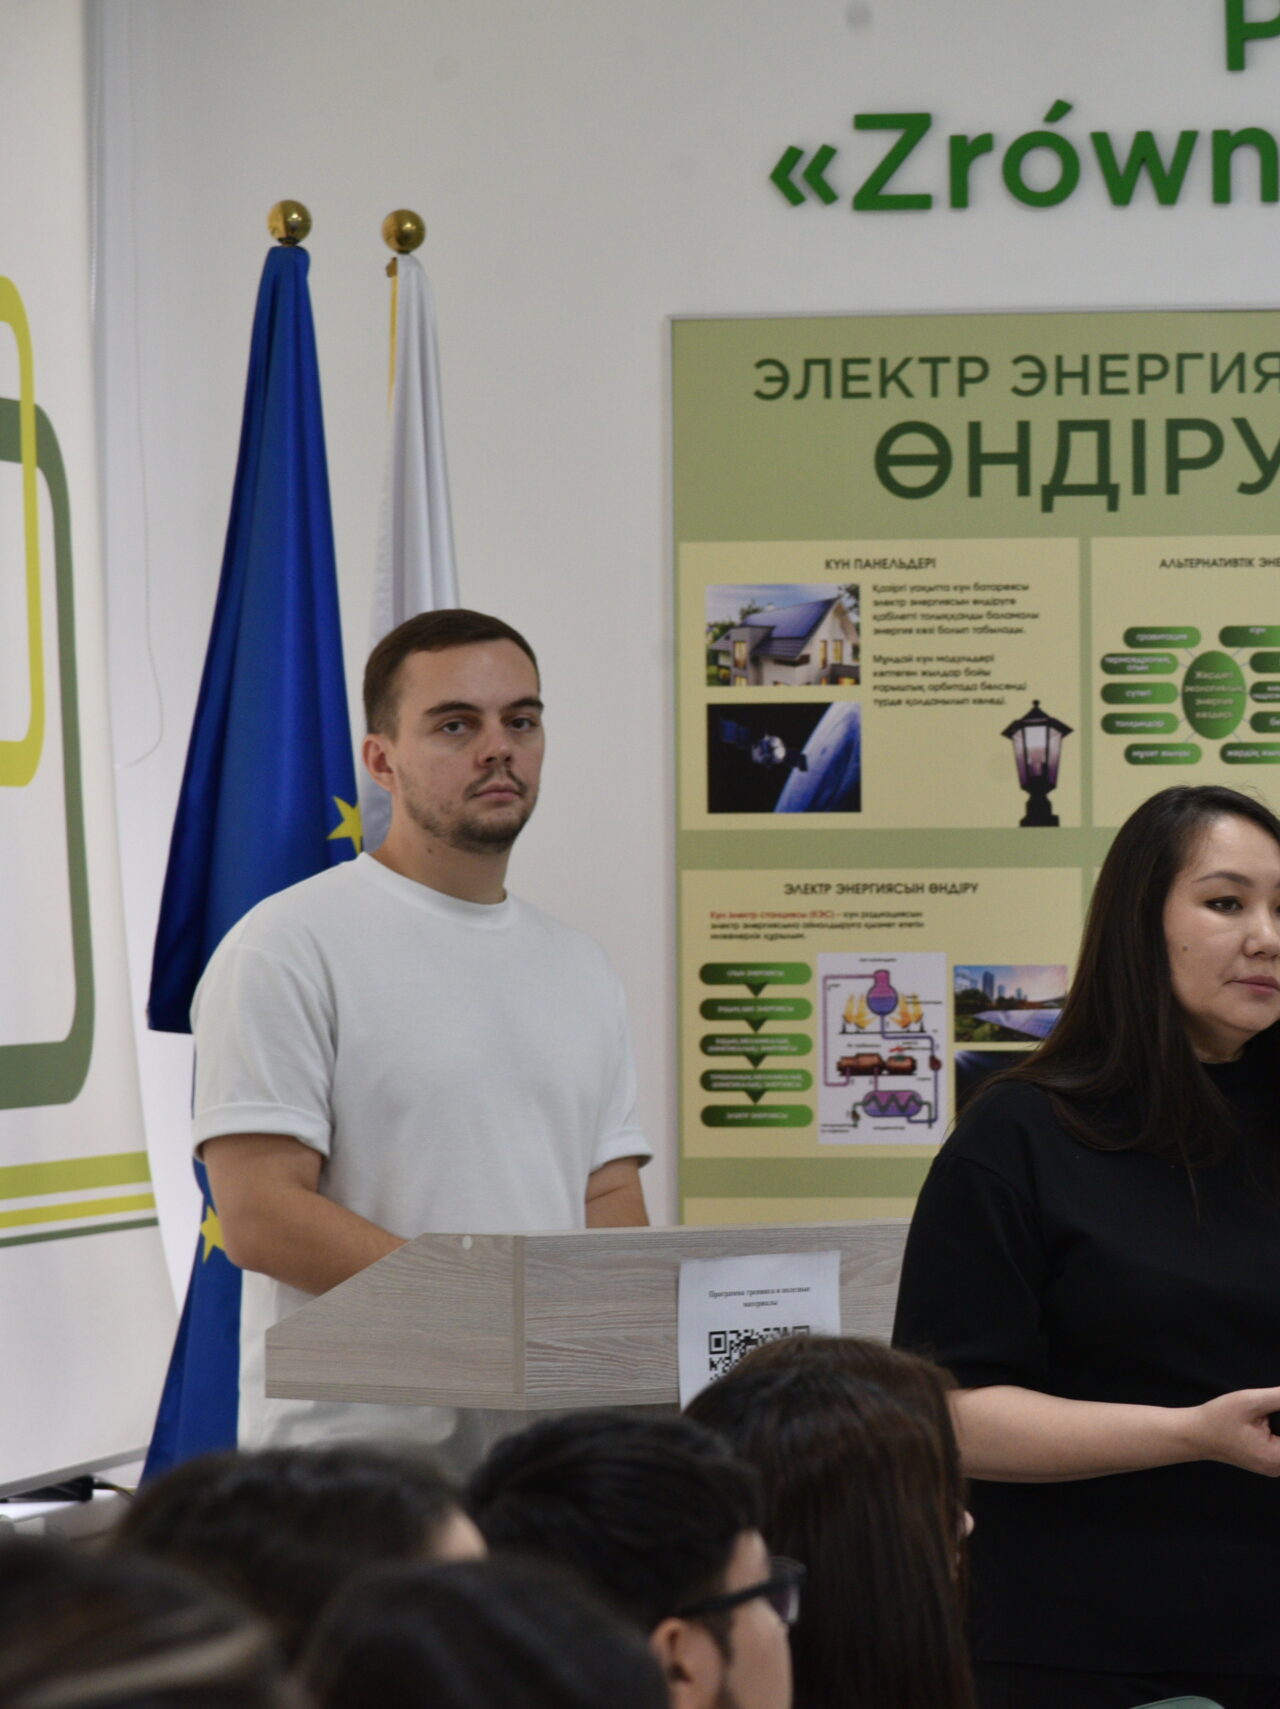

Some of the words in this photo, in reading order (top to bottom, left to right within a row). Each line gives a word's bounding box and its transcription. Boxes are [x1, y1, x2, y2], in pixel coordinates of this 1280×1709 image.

[753, 356, 990, 401] ЭЛЕКТР
[784, 883, 832, 895] ЭЛЕКТР
[836, 883, 925, 895] ЭНЕРГИЯСЫН
[929, 882, 979, 895] ӨНДІРУ
